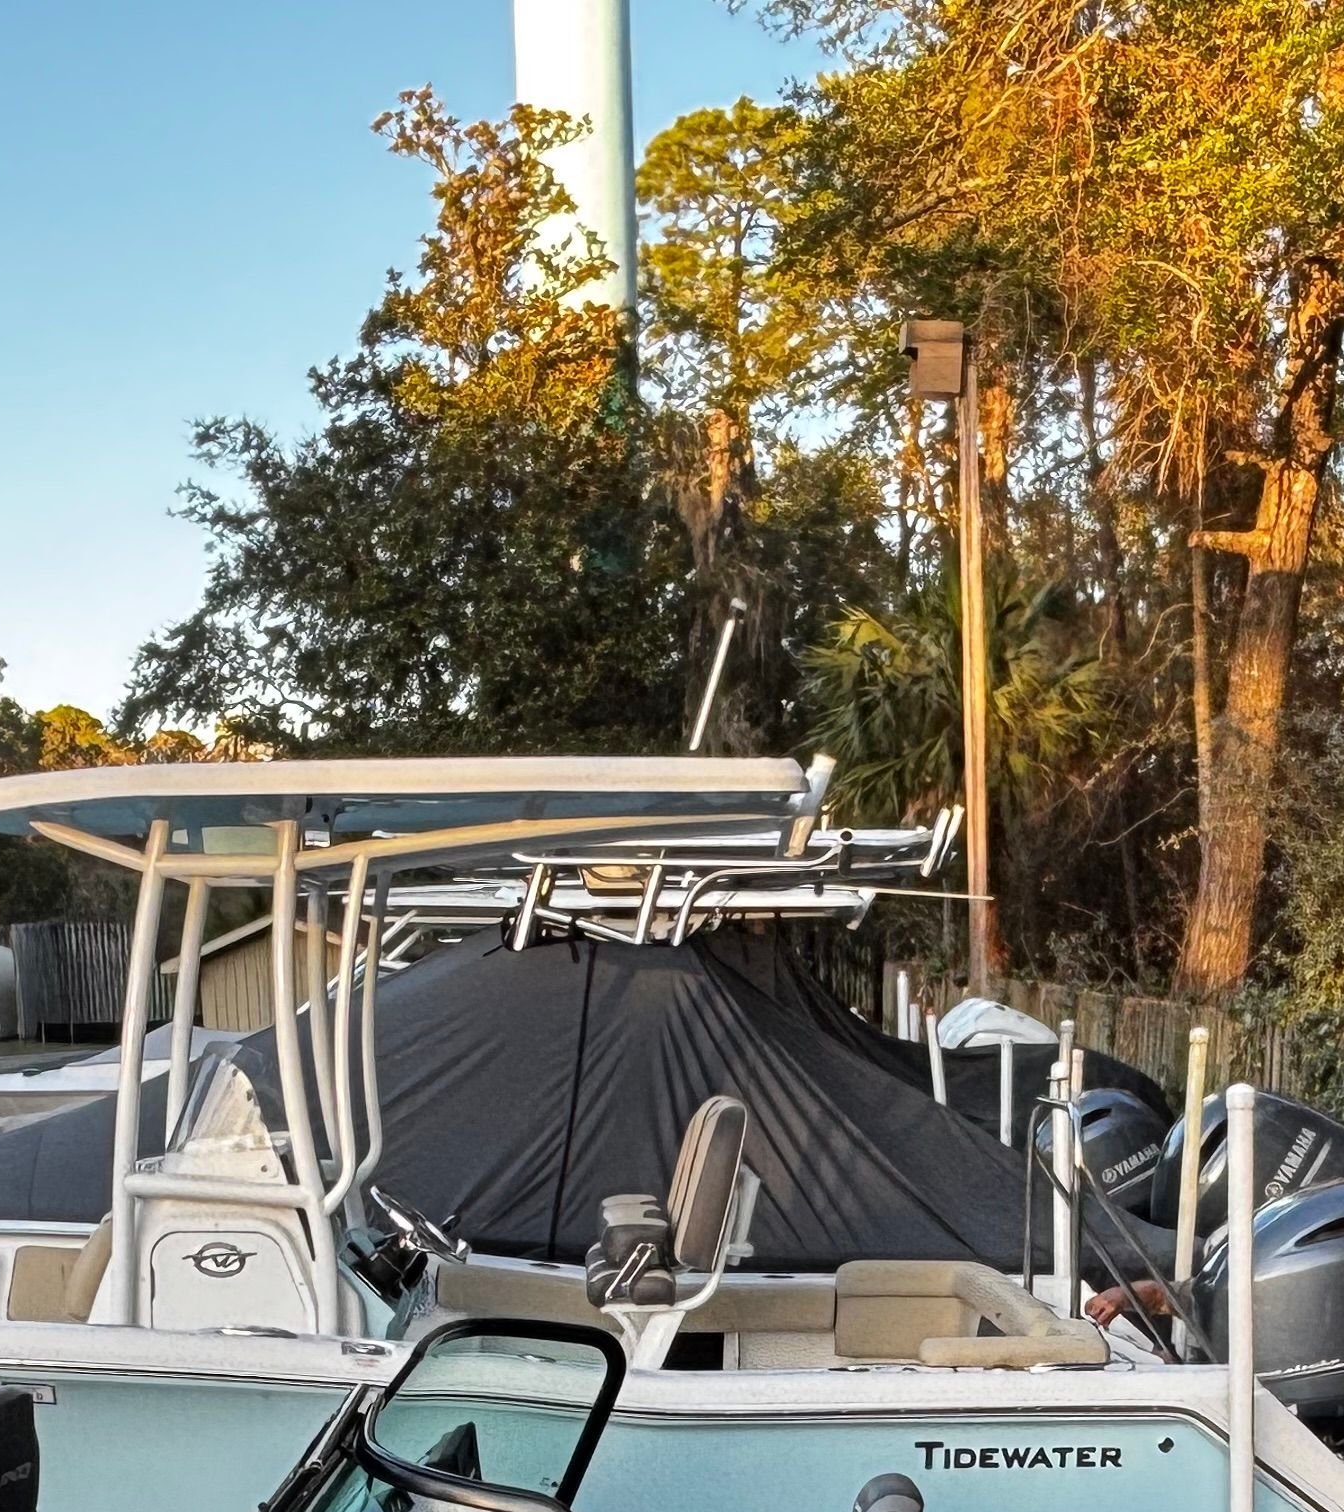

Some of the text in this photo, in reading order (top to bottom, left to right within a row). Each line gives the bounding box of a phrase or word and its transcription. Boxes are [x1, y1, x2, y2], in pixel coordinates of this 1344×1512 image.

[1115, 1143, 1161, 1176] YAMAHA
[1276, 1127, 1317, 1189] YAMAHA
[914, 1441, 1123, 1470] TIDEWATER
